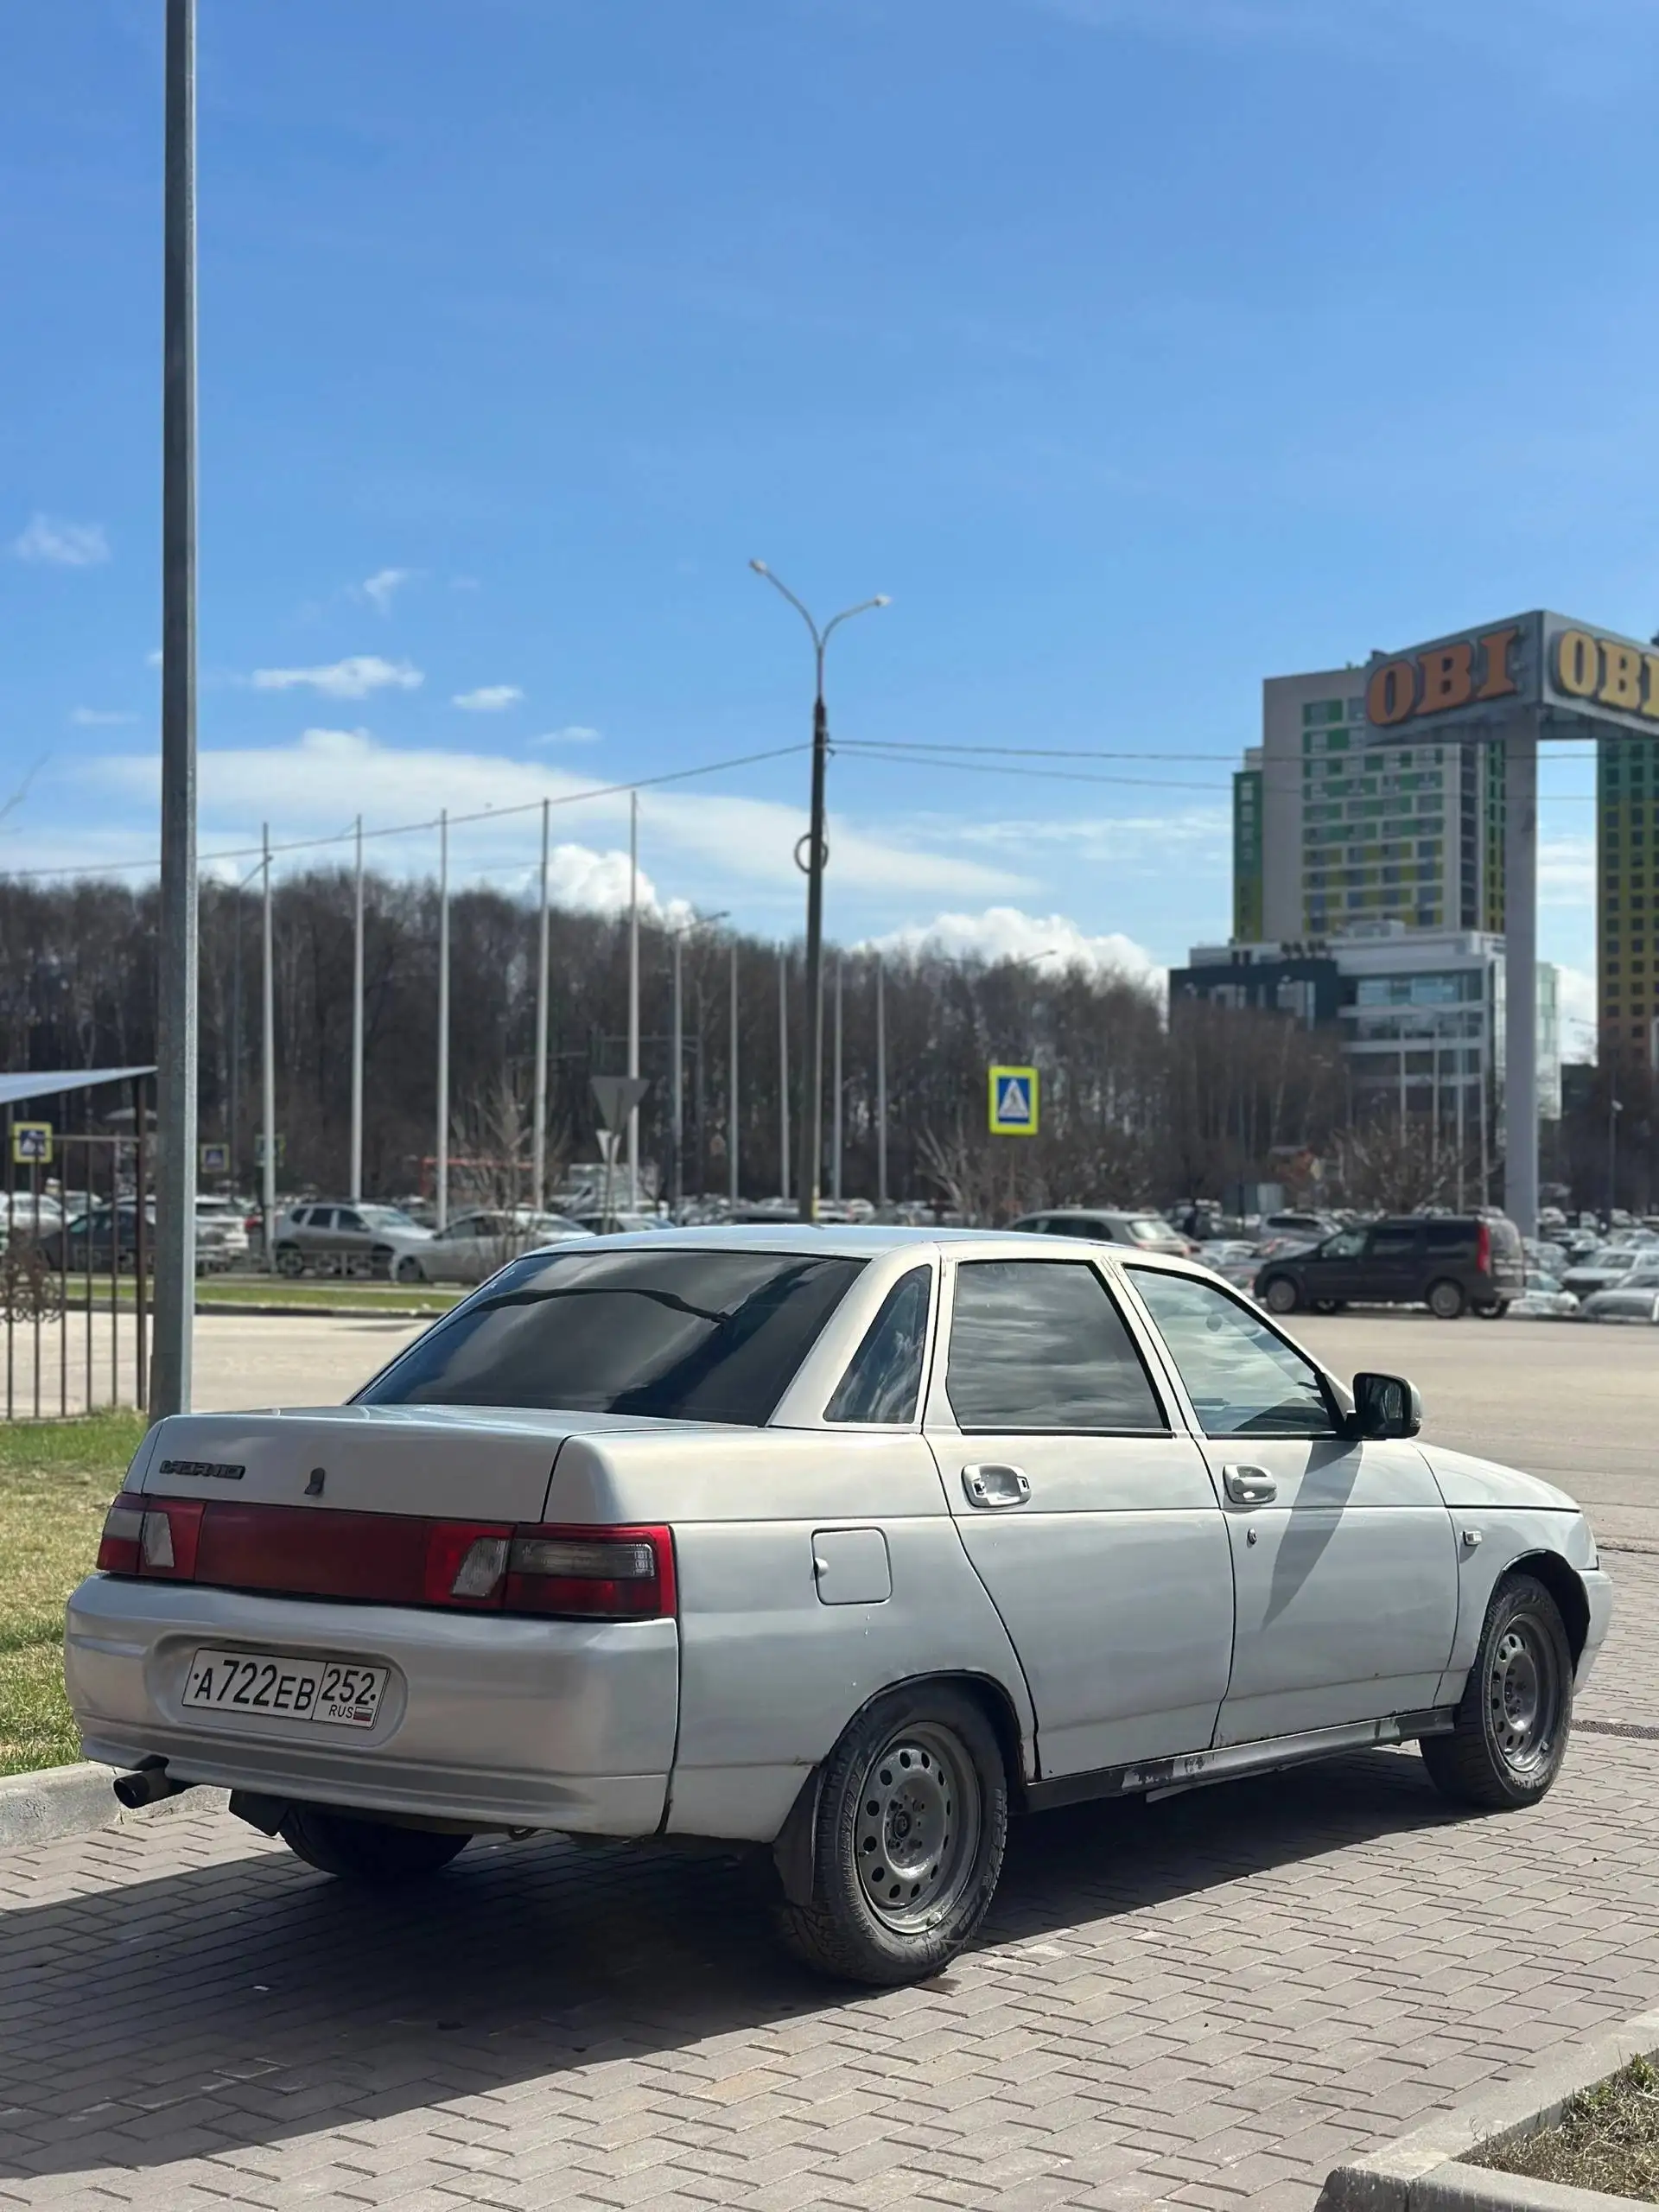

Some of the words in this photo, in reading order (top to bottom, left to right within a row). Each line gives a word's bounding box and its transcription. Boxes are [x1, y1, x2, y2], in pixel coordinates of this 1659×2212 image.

[1367, 626, 1518, 725] OBI
[321, 1669, 374, 1705] 252
[328, 1704, 353, 1719] RUS
